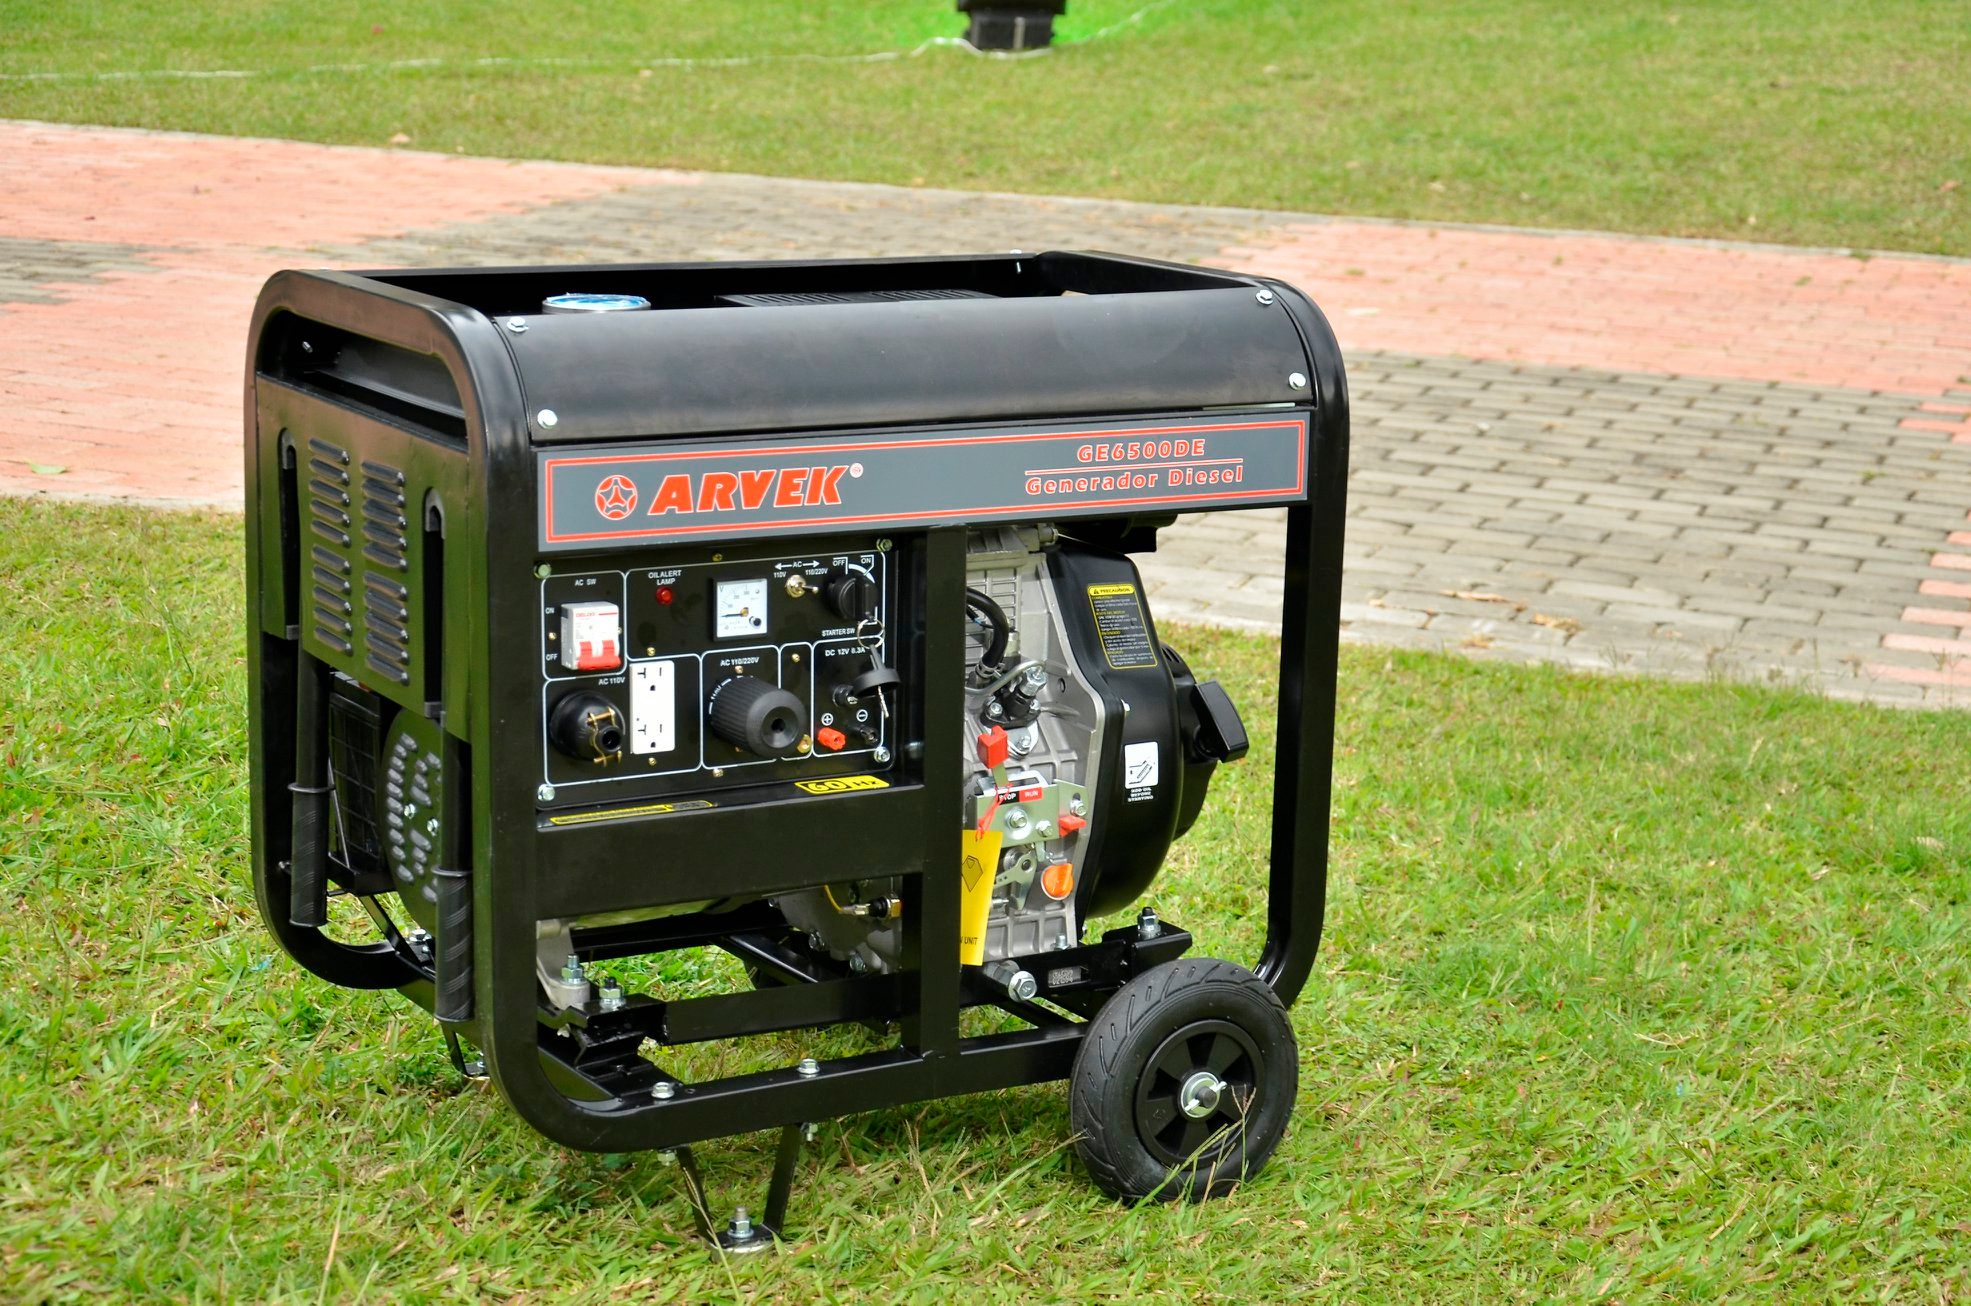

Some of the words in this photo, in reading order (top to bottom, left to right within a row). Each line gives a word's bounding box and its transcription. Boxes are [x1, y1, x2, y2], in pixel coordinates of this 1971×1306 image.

[1077, 438, 1206, 462] GE6500DE
[1025, 472, 1158, 495] Generador
[1168, 465, 1243, 487] Diesel
[647, 464, 850, 516] ARVEK
[832, 559, 845, 567] OFF
[861, 557, 872, 565] ON
[659, 569, 682, 578] ALERT
[773, 571, 787, 579] 110V
[805, 567, 829, 576] 110/220V
[574, 579, 584, 587] AC
[586, 577, 597, 586] SW
[656, 577, 676, 586] LAMP
[545, 607, 555, 615] ON
[821, 629, 845, 637] STARTER
[845, 628, 856, 636] SW
[546, 653, 558, 661] OFF
[825, 649, 835, 657] DC
[837, 648, 850, 656] 12V
[720, 659, 731, 667] AC
[731, 656, 760, 666] 110/220V
[598, 677, 609, 686] AC
[609, 676, 626, 686] 110V
[1024, 790, 1039, 798] RUN
